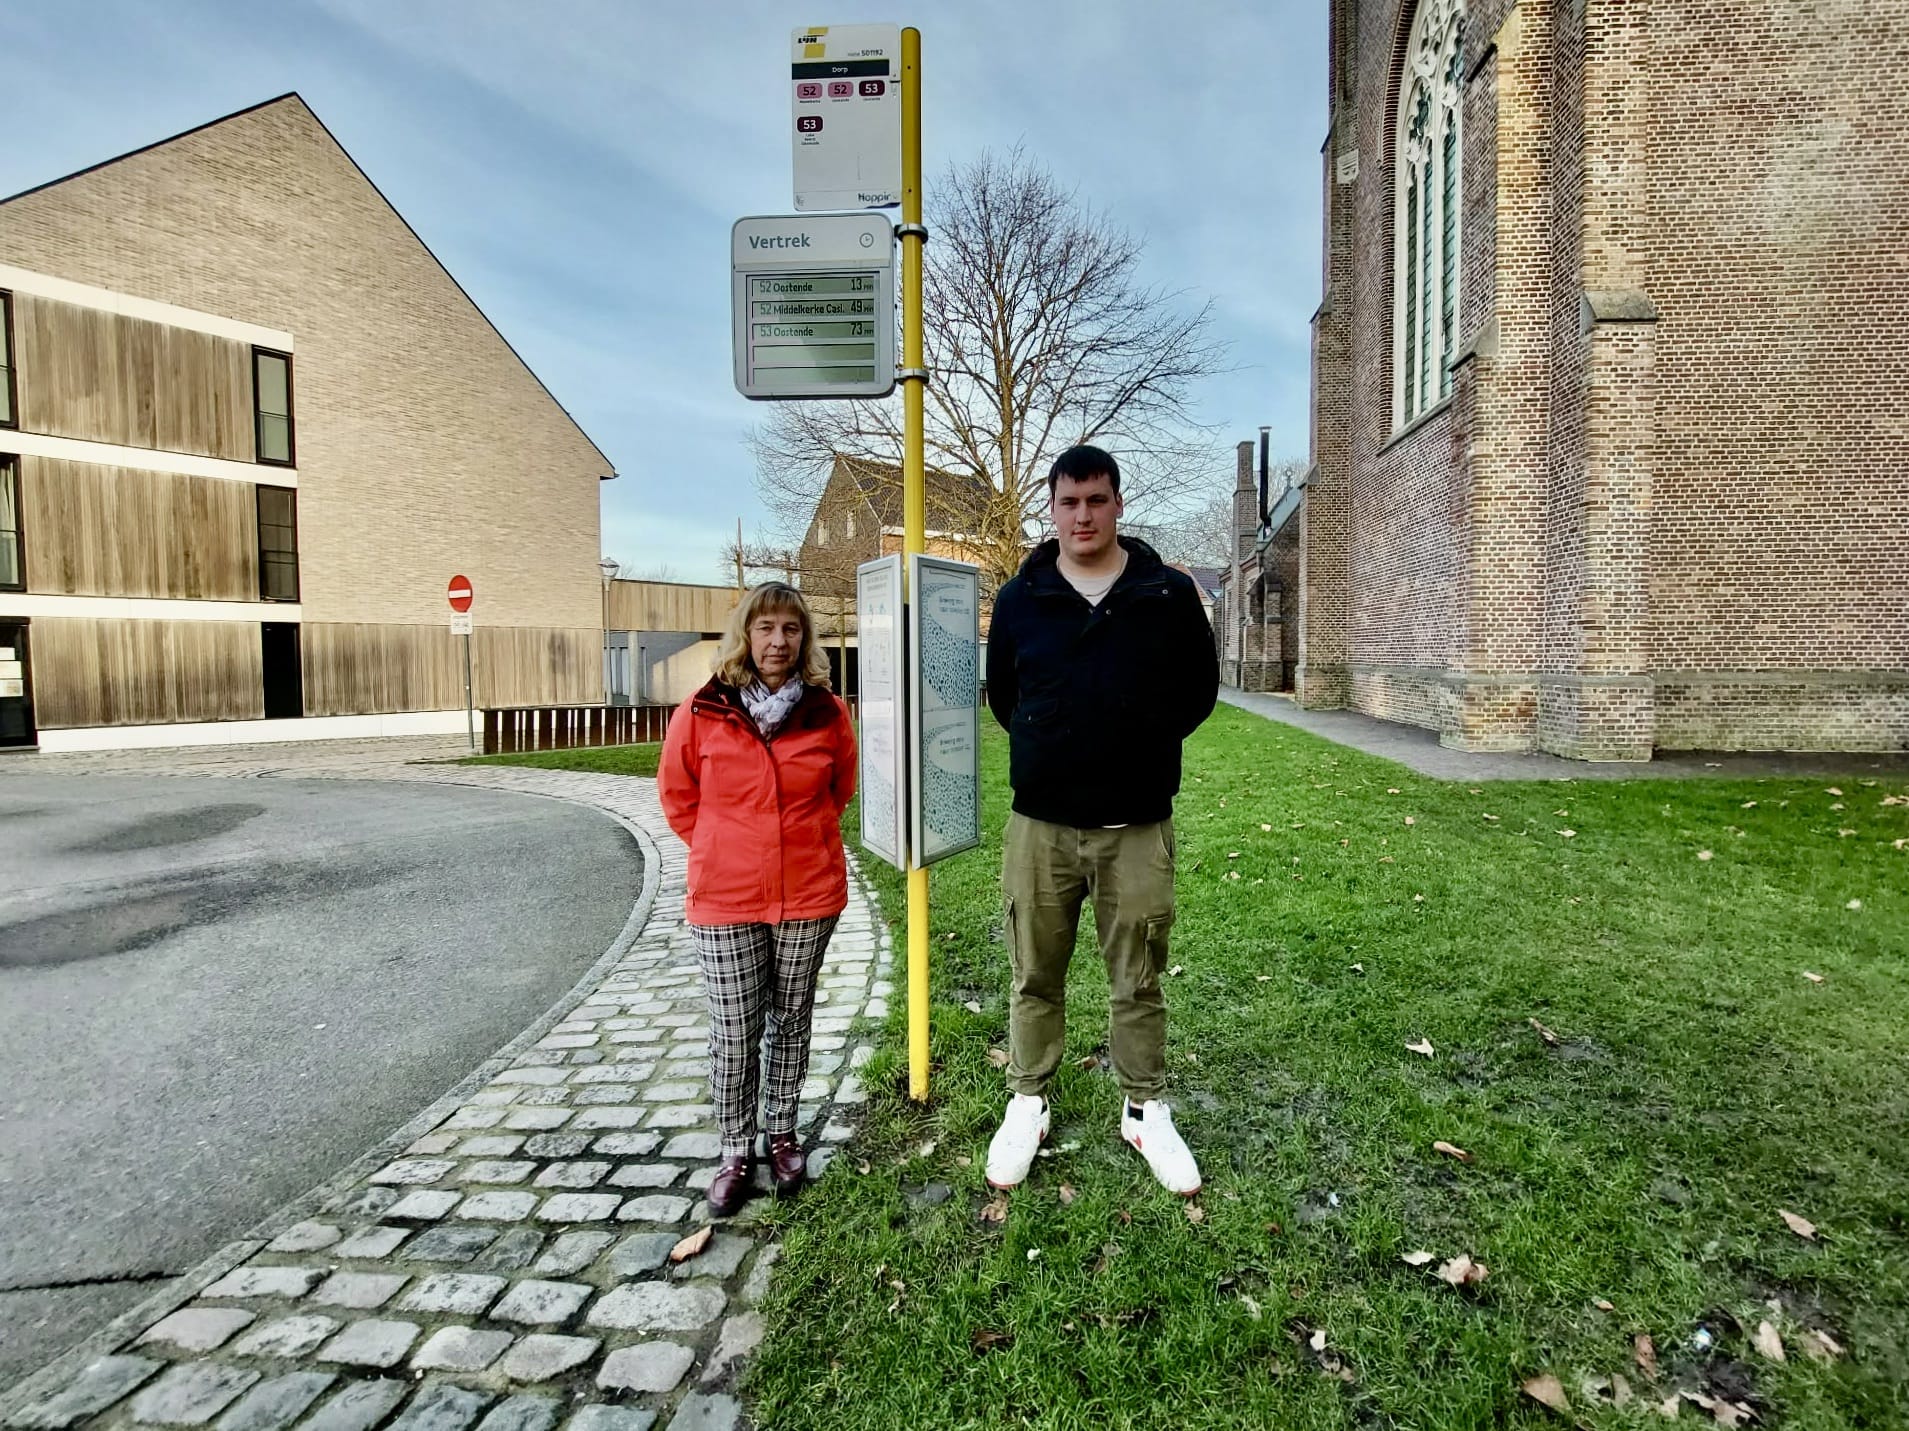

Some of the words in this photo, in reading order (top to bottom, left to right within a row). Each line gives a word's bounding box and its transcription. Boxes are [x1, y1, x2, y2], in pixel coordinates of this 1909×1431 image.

[803, 86, 817, 96] 52
[834, 85, 848, 95] 52
[865, 83, 879, 94] 53
[803, 119, 817, 130] 53
[749, 233, 811, 249] Vertrek
[759, 280, 772, 293] 52
[773, 282, 813, 292] Oostende
[851, 278, 862, 291] 13
[760, 304, 772, 315] 52
[773, 303, 825, 315] Middelkerke
[851, 301, 863, 313] 49
[760, 325, 772, 337] 53
[773, 326, 814, 337] Oostende
[850, 322, 863, 335] 73
